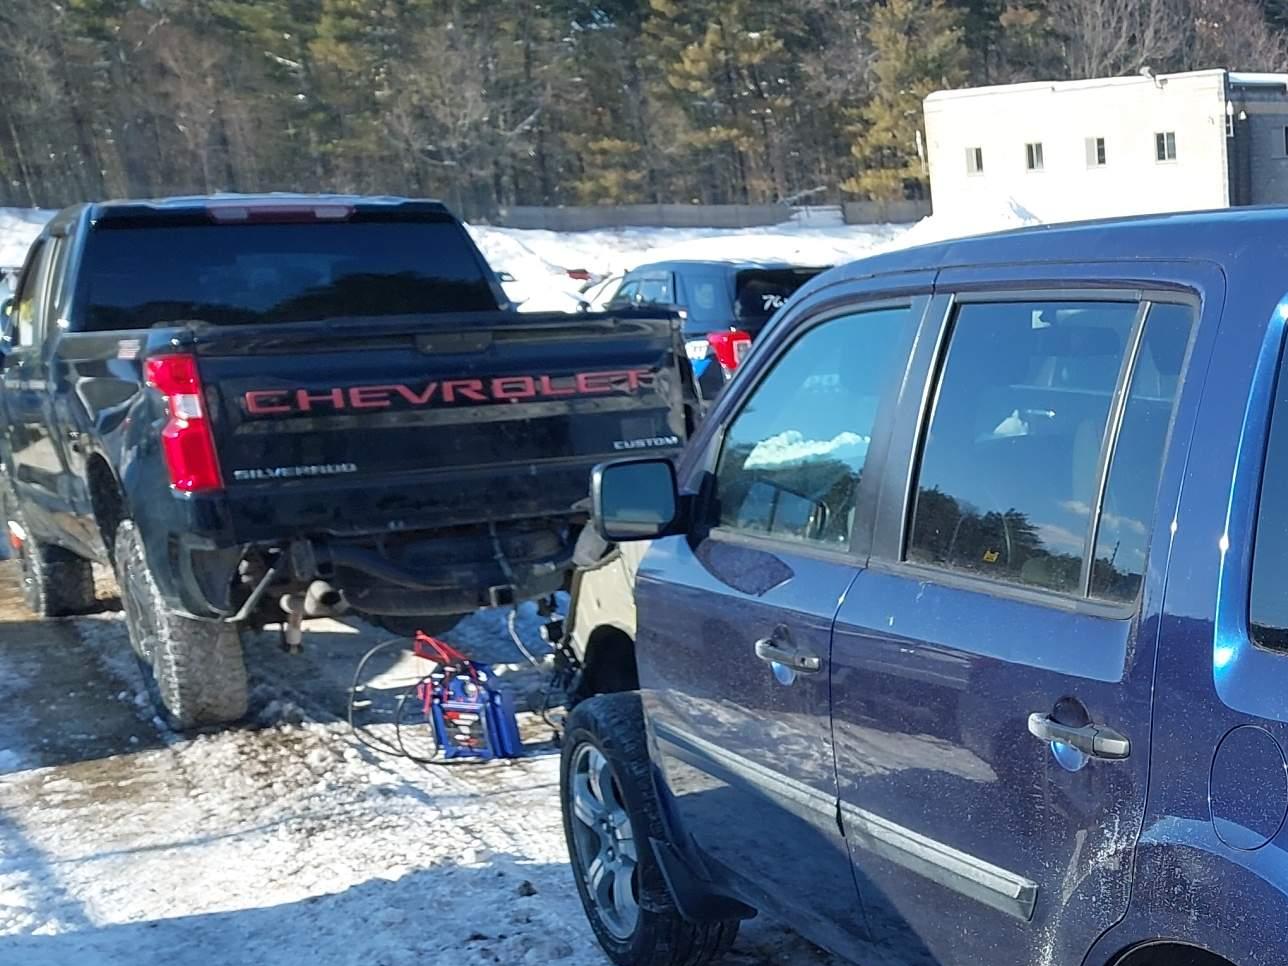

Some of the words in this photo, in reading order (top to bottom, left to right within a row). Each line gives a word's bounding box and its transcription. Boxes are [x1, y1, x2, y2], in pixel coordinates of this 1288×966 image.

[244, 369, 655, 415] CHEVROLET
[613, 435, 679, 450] CUSTOM
[233, 463, 358, 480] SILVERADO
